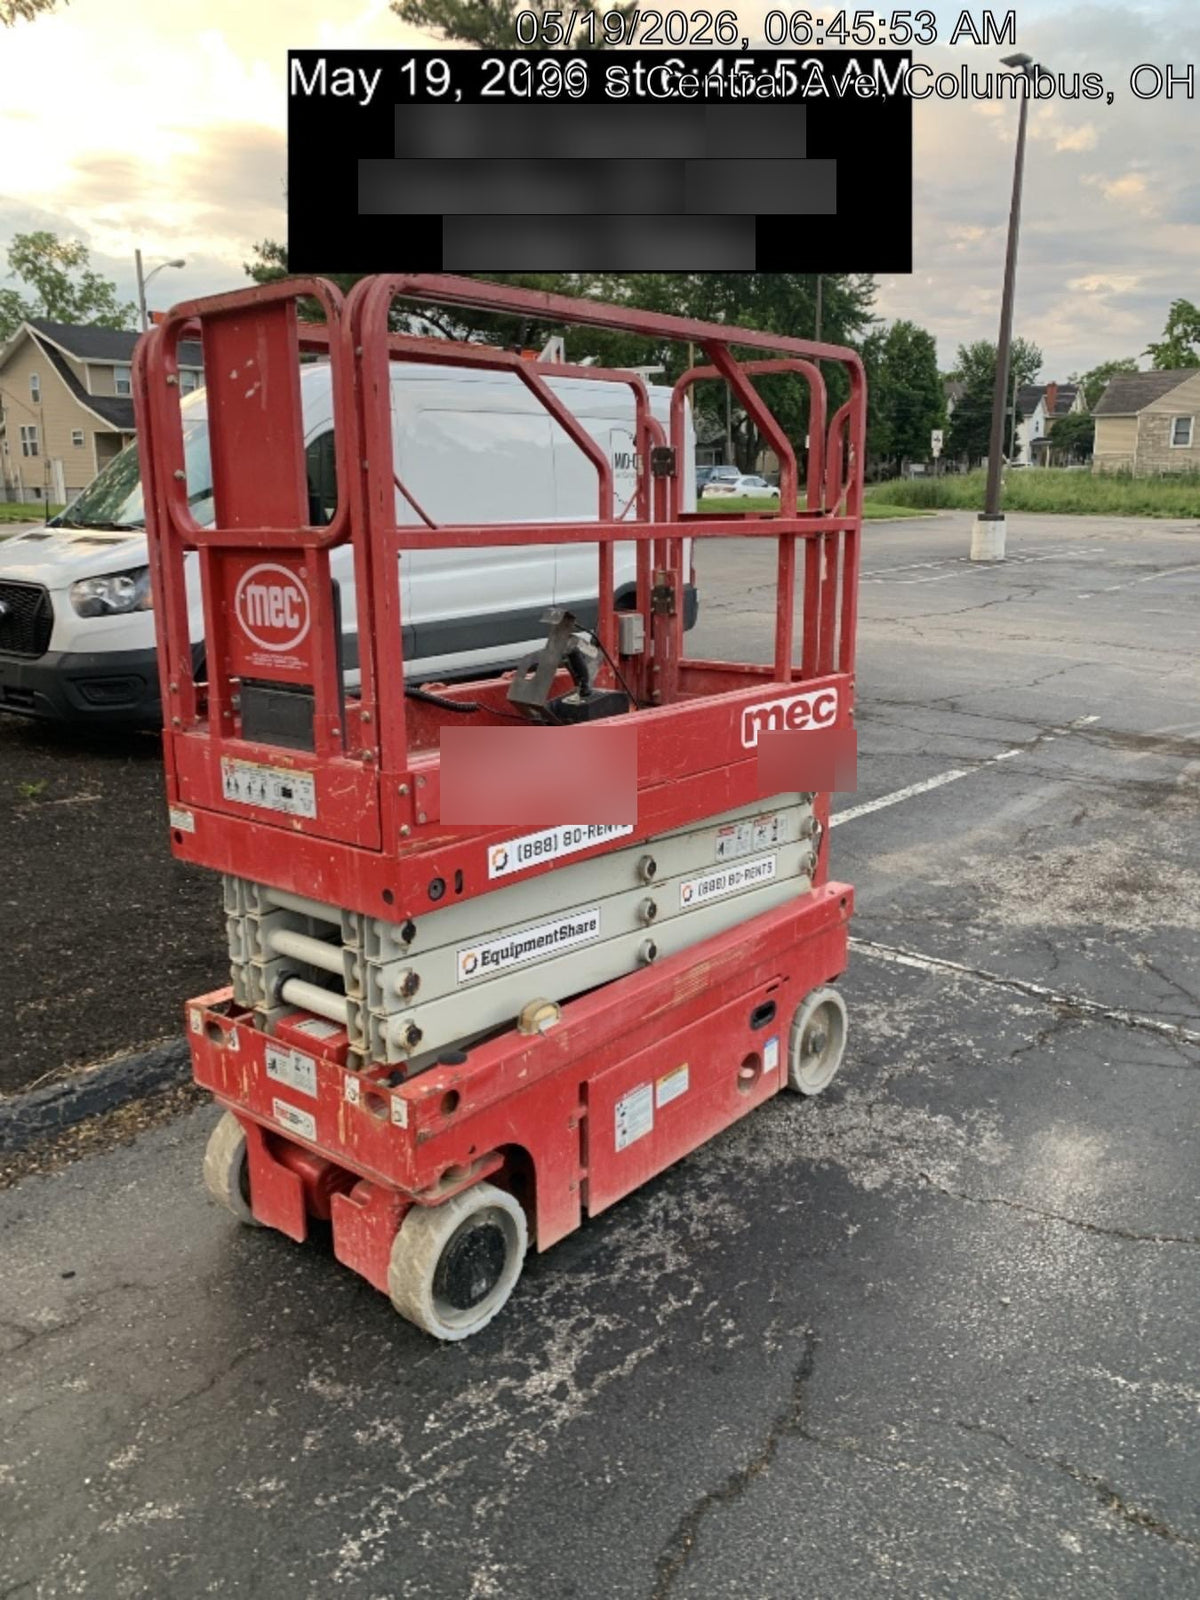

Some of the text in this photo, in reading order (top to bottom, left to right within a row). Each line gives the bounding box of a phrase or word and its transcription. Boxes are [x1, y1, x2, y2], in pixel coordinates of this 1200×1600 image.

[246, 584, 300, 629] mec
[745, 694, 835, 742] mec
[517, 833, 558, 862] (888)
[480, 919, 597, 967] EquipmentShare
